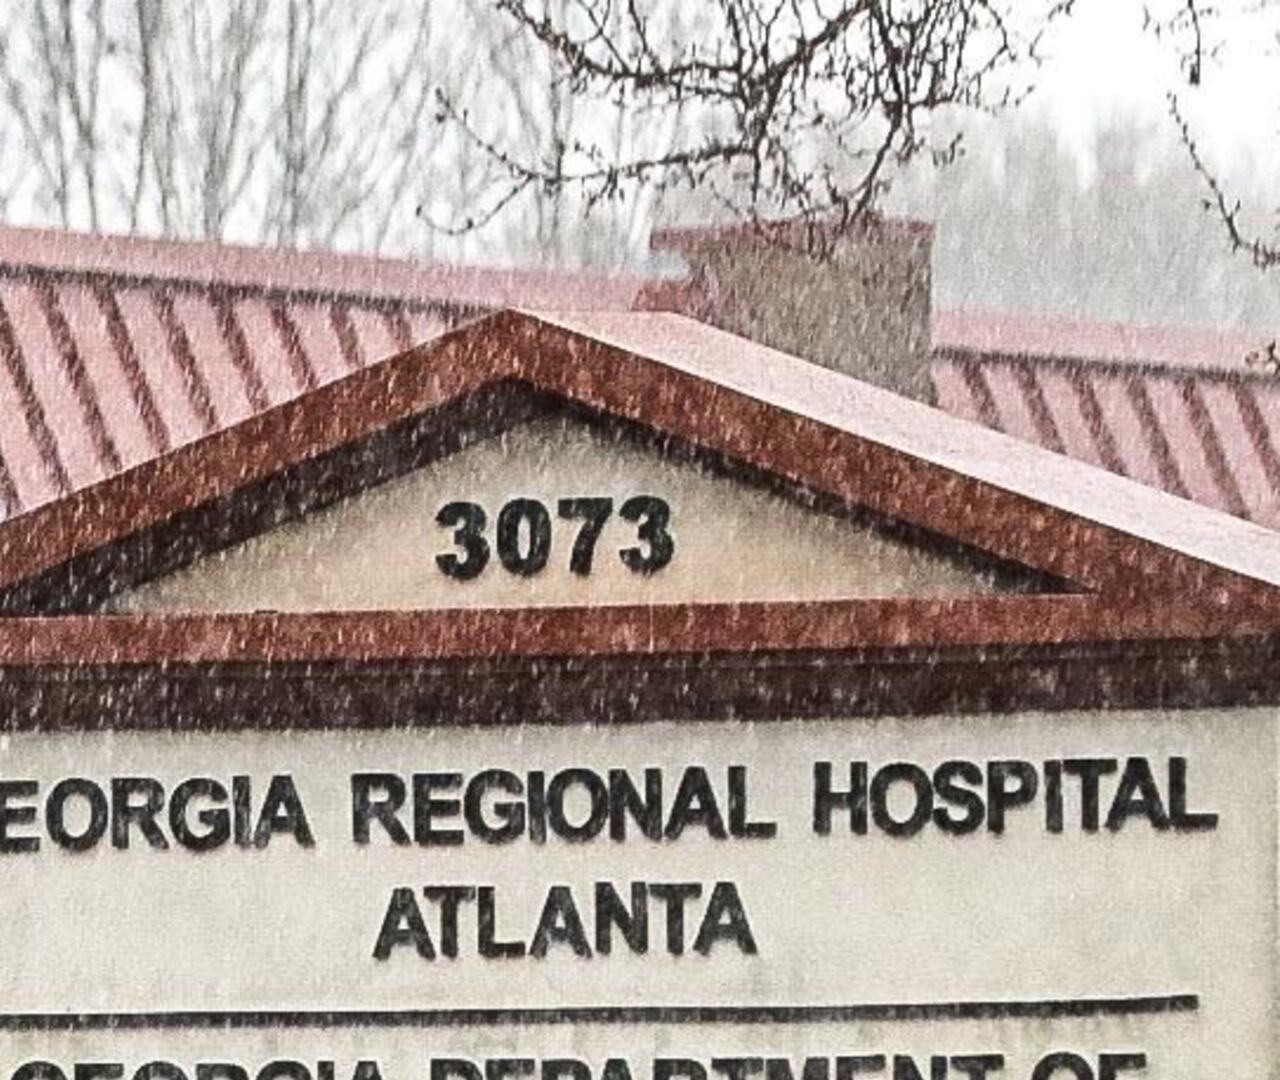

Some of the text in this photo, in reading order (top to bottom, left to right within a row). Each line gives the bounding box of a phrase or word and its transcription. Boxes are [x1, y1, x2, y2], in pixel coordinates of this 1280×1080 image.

[434, 495, 675, 580] 3073
[351, 766, 777, 848] REGIONAL
[813, 756, 1218, 836] HOSPITAL
[372, 880, 757, 960] ATLANTA
